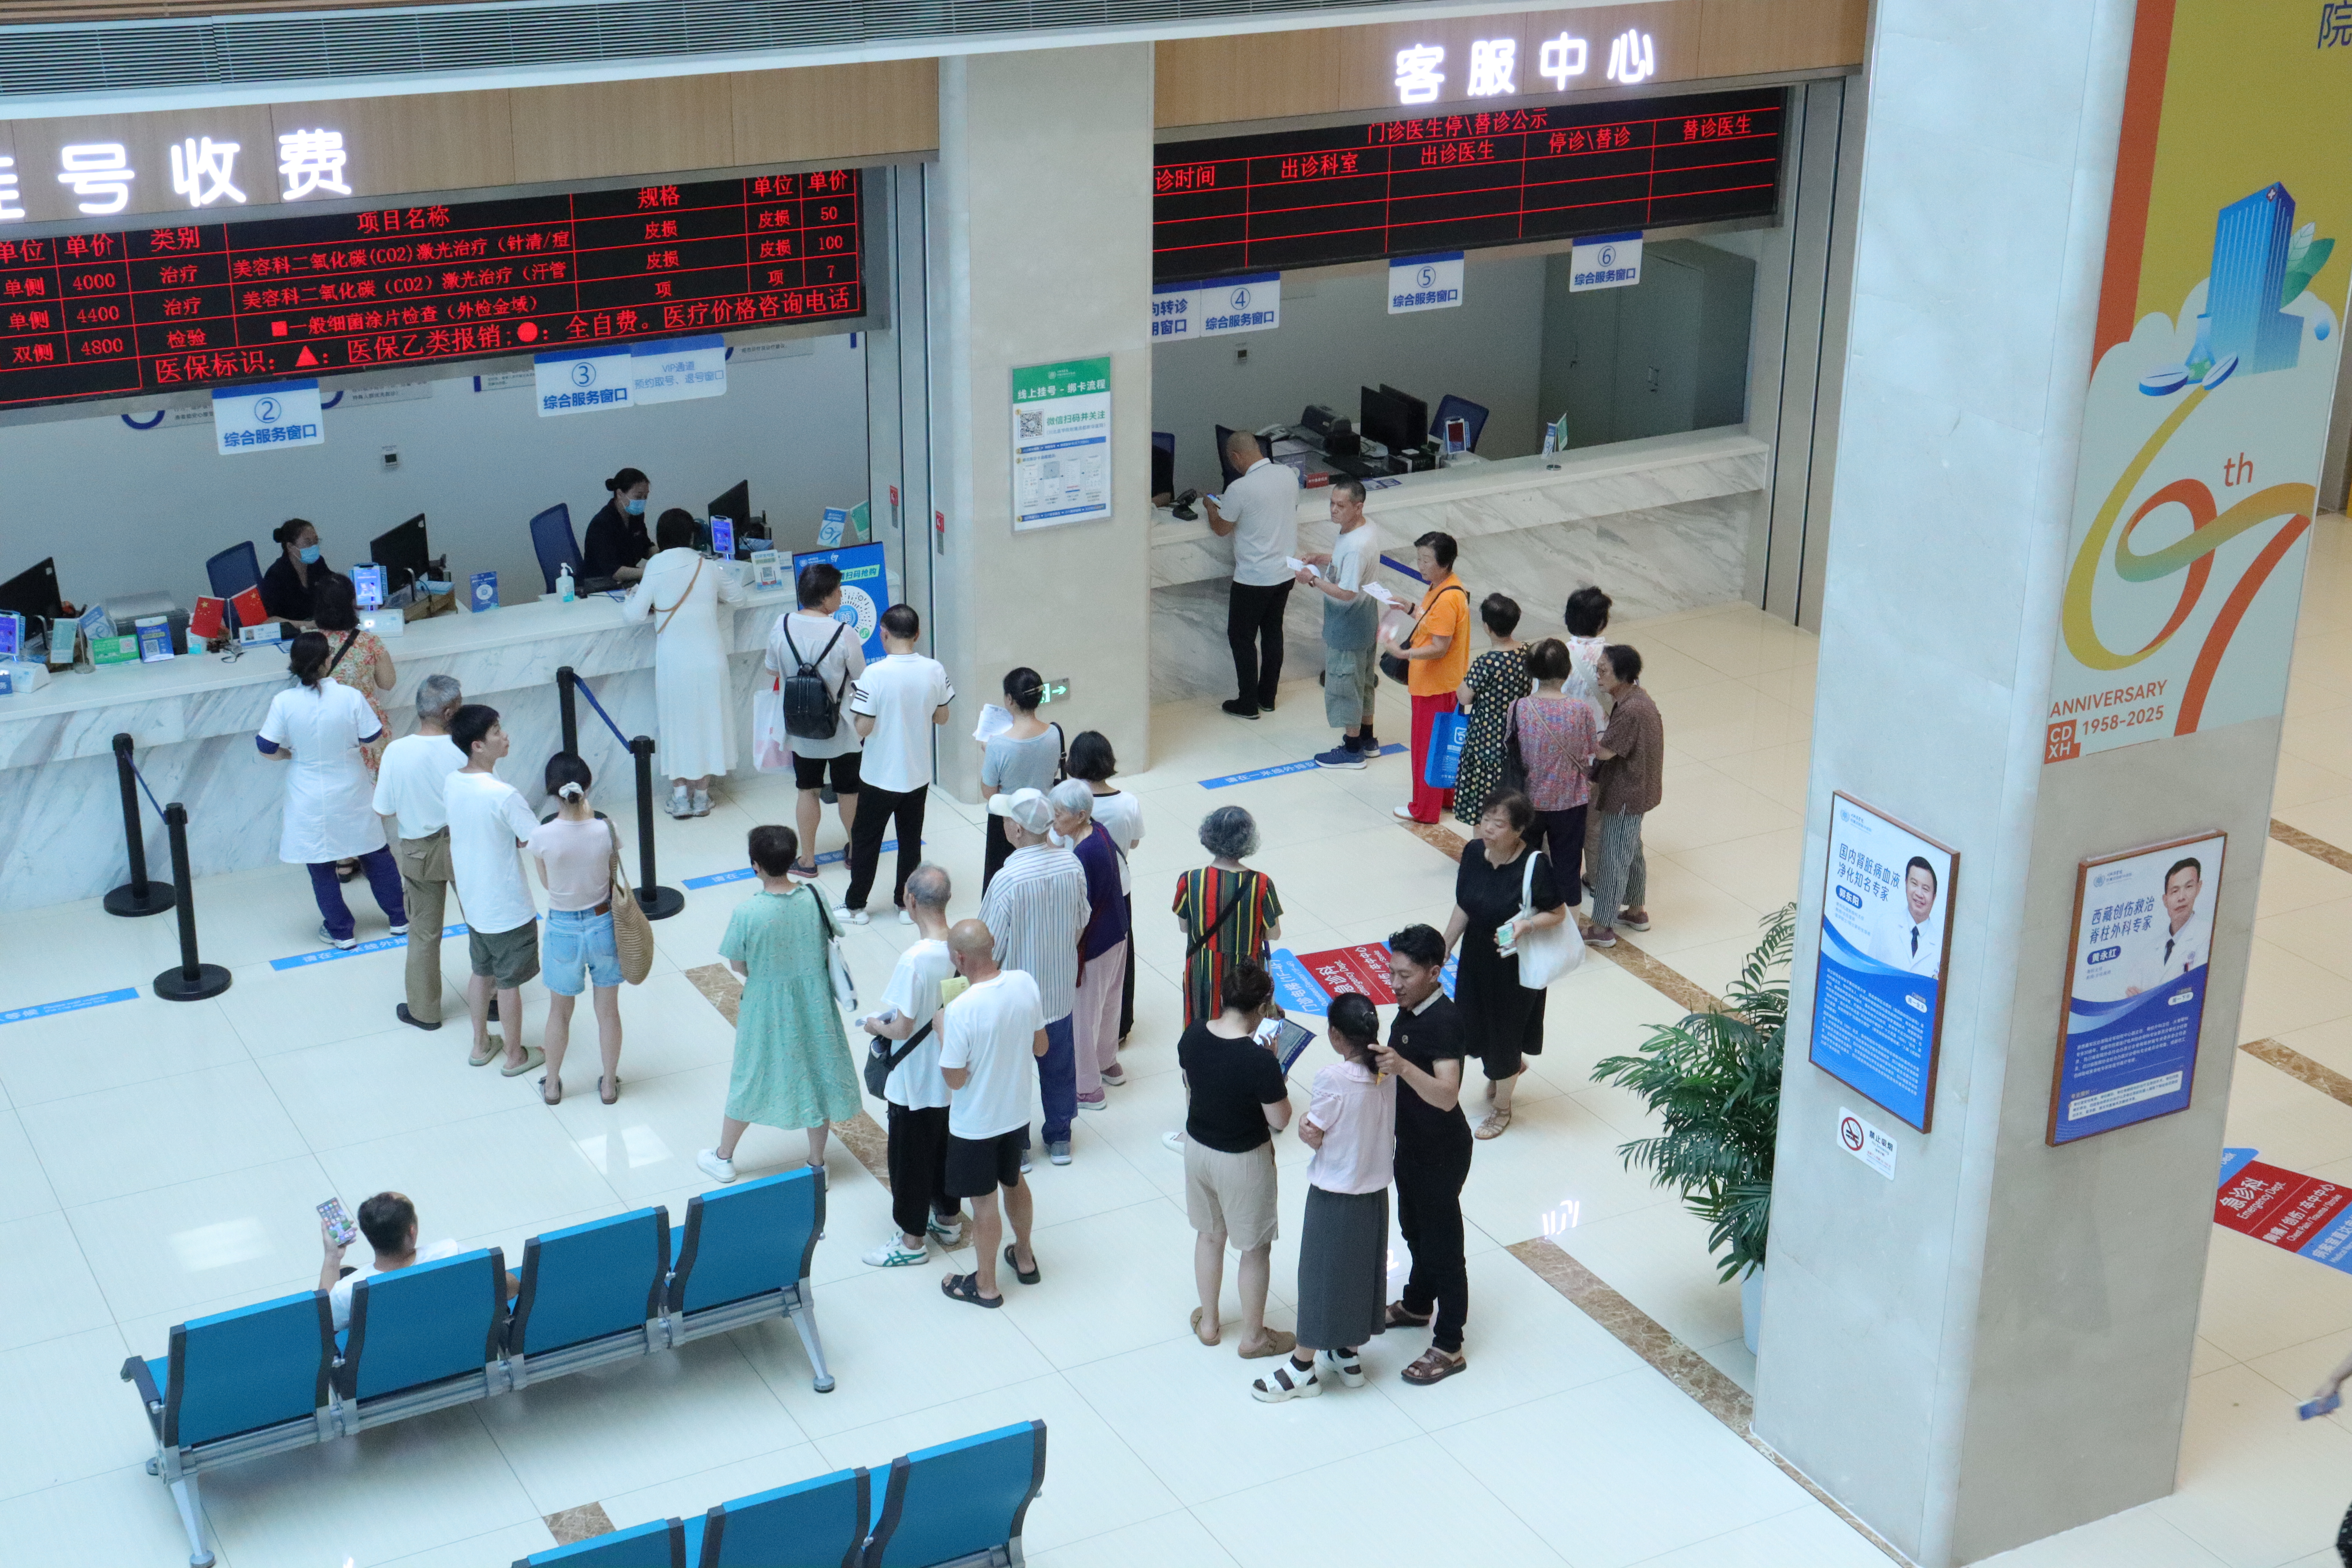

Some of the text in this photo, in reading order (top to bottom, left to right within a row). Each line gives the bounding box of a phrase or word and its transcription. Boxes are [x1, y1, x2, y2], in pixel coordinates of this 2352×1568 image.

[1395, 29, 1653, 104] 客服中心
[1281, 152, 1359, 179] 出诊科室
[1421, 139, 1495, 166] 出诊医生
[1683, 115, 1752, 141] 替诊医生
[64, 232, 114, 257] 单价
[151, 226, 200, 251] 类别
[357, 204, 450, 234] 项目名称
[638, 185, 681, 209] 规格
[752, 175, 793, 197] 单位
[808, 169, 848, 190] 单价
[4, 278, 45, 299] 单侧
[72, 273, 116, 291] 4000
[160, 265, 199, 284] 治疗
[644, 220, 678, 240] 皮损
[758, 210, 790, 229] 皮损
[820, 206, 838, 221] 50
[8, 310, 49, 330] 单侧
[76, 306, 120, 324] 4400
[163, 297, 202, 317] 治疗
[646, 250, 680, 270] 皮损
[759, 239, 791, 258] 皮损
[819, 235, 843, 250] 100
[1574, 268, 1636, 285] 综合服务窗口
[1393, 289, 1457, 307] 综合服务窗口
[12, 343, 54, 363] 双侧
[80, 338, 123, 356] 4800
[166, 329, 207, 349] 检验
[655, 281, 672, 298] 项
[768, 270, 784, 287] 项
[827, 265, 835, 278] 7
[1205, 311, 1274, 330] 综合服务窗口
[634, 370, 724, 390] 预约取号、退号窗口
[662, 361, 695, 372] VIP通道
[543, 388, 627, 410] 综合服务窗口
[1047, 410, 1105, 426] 微信扫码并关注
[224, 424, 317, 447] 综合服务窗口
[2223, 452, 2253, 487] th
[2049, 679, 2168, 718] ANNIVERSARY
[2050, 725, 2073, 743] CD
[2082, 705, 2164, 736] 1958-2025
[2049, 743, 2071, 759] XH
[1839, 843, 1900, 889] 国内肾脏病血液
[1838, 862, 1889, 902] 净化知名专家
[1838, 888, 1860, 907] 郭东阳
[2092, 896, 2154, 925] 西藏创伤救治
[2090, 915, 2152, 944] 脊柱外科专家
[1869, 1130, 1893, 1152] 禁止吸烟
[2220, 1177, 2269, 1210] 急诊科
[2236, 1193, 2274, 1220] Emergency
